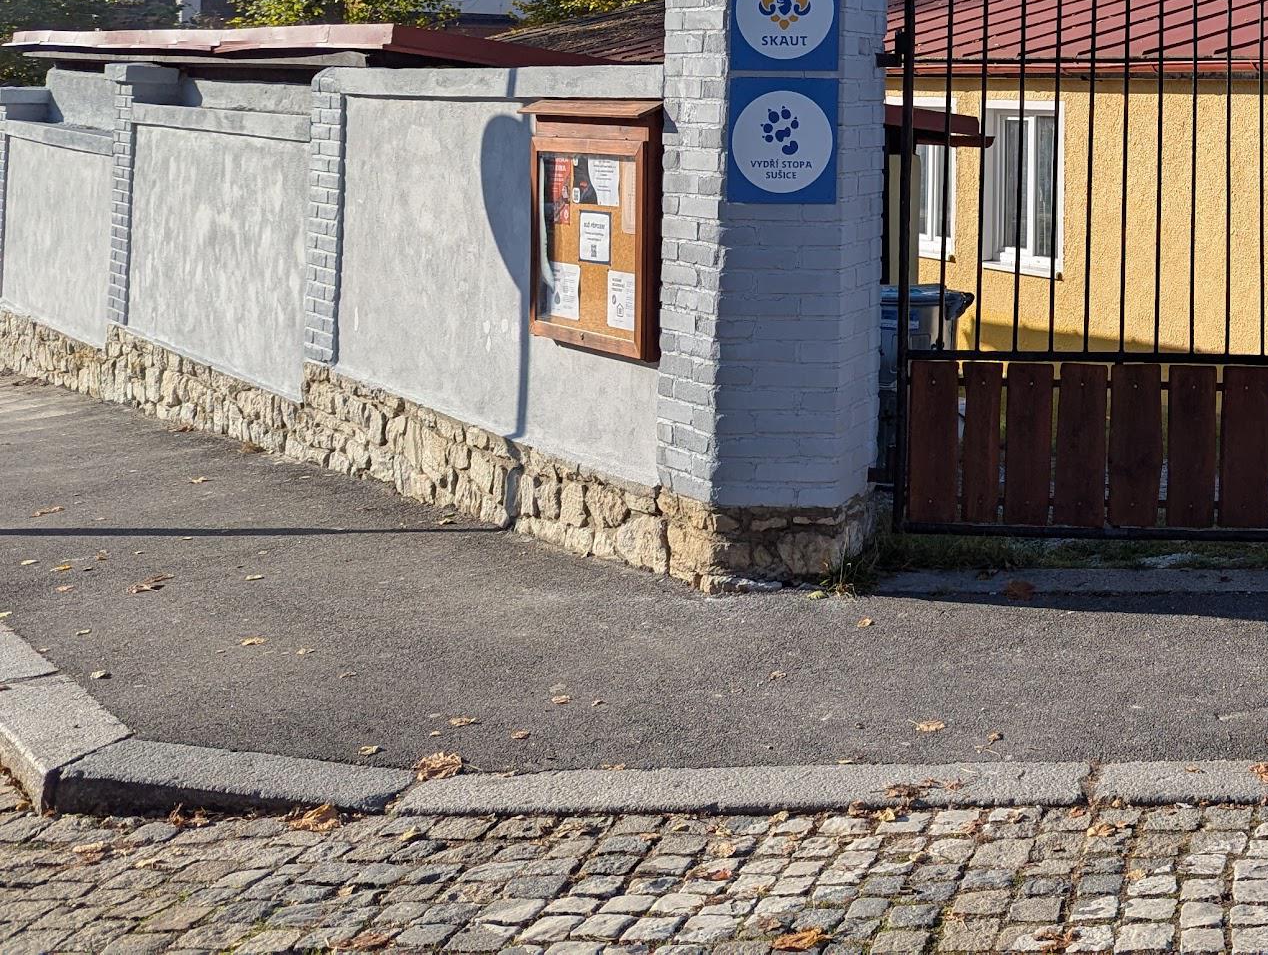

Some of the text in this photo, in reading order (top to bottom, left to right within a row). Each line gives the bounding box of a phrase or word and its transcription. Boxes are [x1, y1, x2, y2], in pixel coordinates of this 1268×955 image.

[761, 35, 808, 47] SKAUT
[750, 159, 812, 169] VYDŘÍ STOPA
[765, 169, 797, 180] SUŠICE
